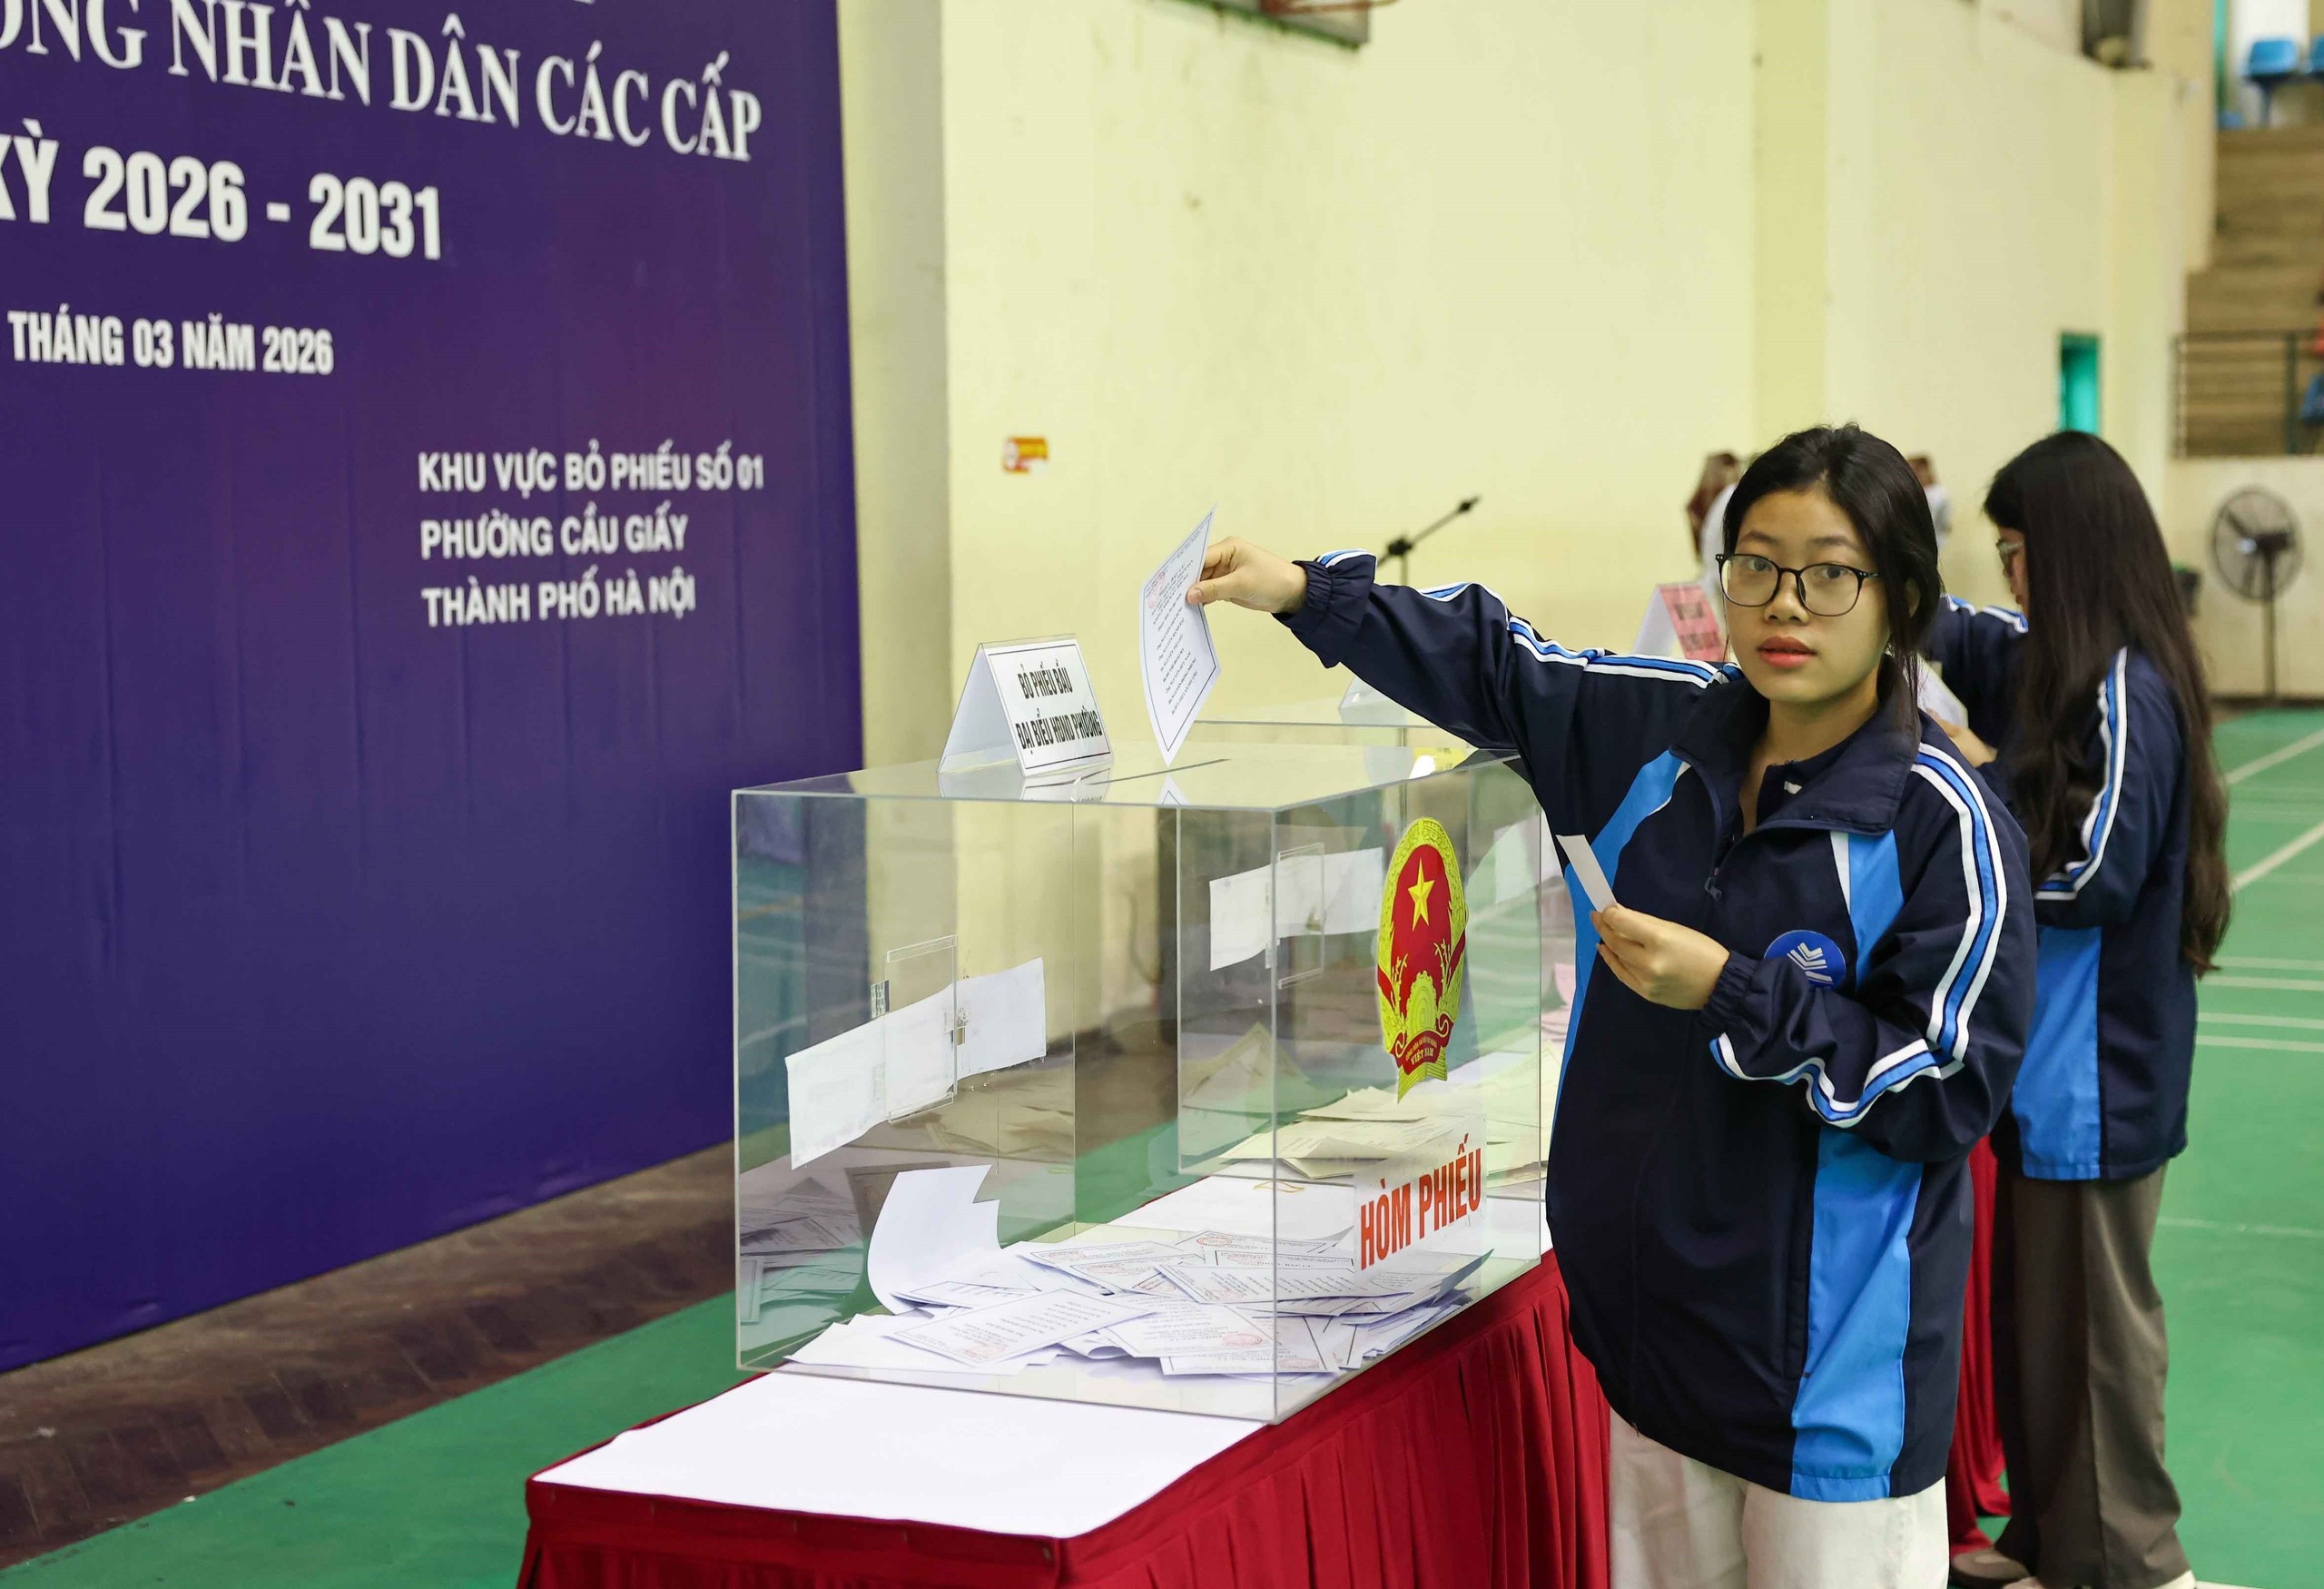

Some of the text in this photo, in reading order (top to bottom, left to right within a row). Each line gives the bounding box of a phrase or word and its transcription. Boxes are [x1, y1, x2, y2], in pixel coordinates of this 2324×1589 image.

[168, 0, 371, 106] NHÂN
[388, 13, 519, 127] DÂN
[536, 40, 651, 147] CÁC
[661, 50, 762, 162] CẤP
[83, 146, 248, 242] 2026
[309, 173, 441, 260] 2031
[7, 303, 334, 375] THÁNG 03 NĂM 2026
[419, 439, 764, 498] KHU VỰC BỎ PHIẾU SỐ 01
[420, 500, 688, 560] PHƯỜNG CẦU GIẤY
[420, 565, 696, 627] THÀNH PHỐ HÀ NỘI
[1360, 1132, 1482, 1270] HÒM PHIẾU
